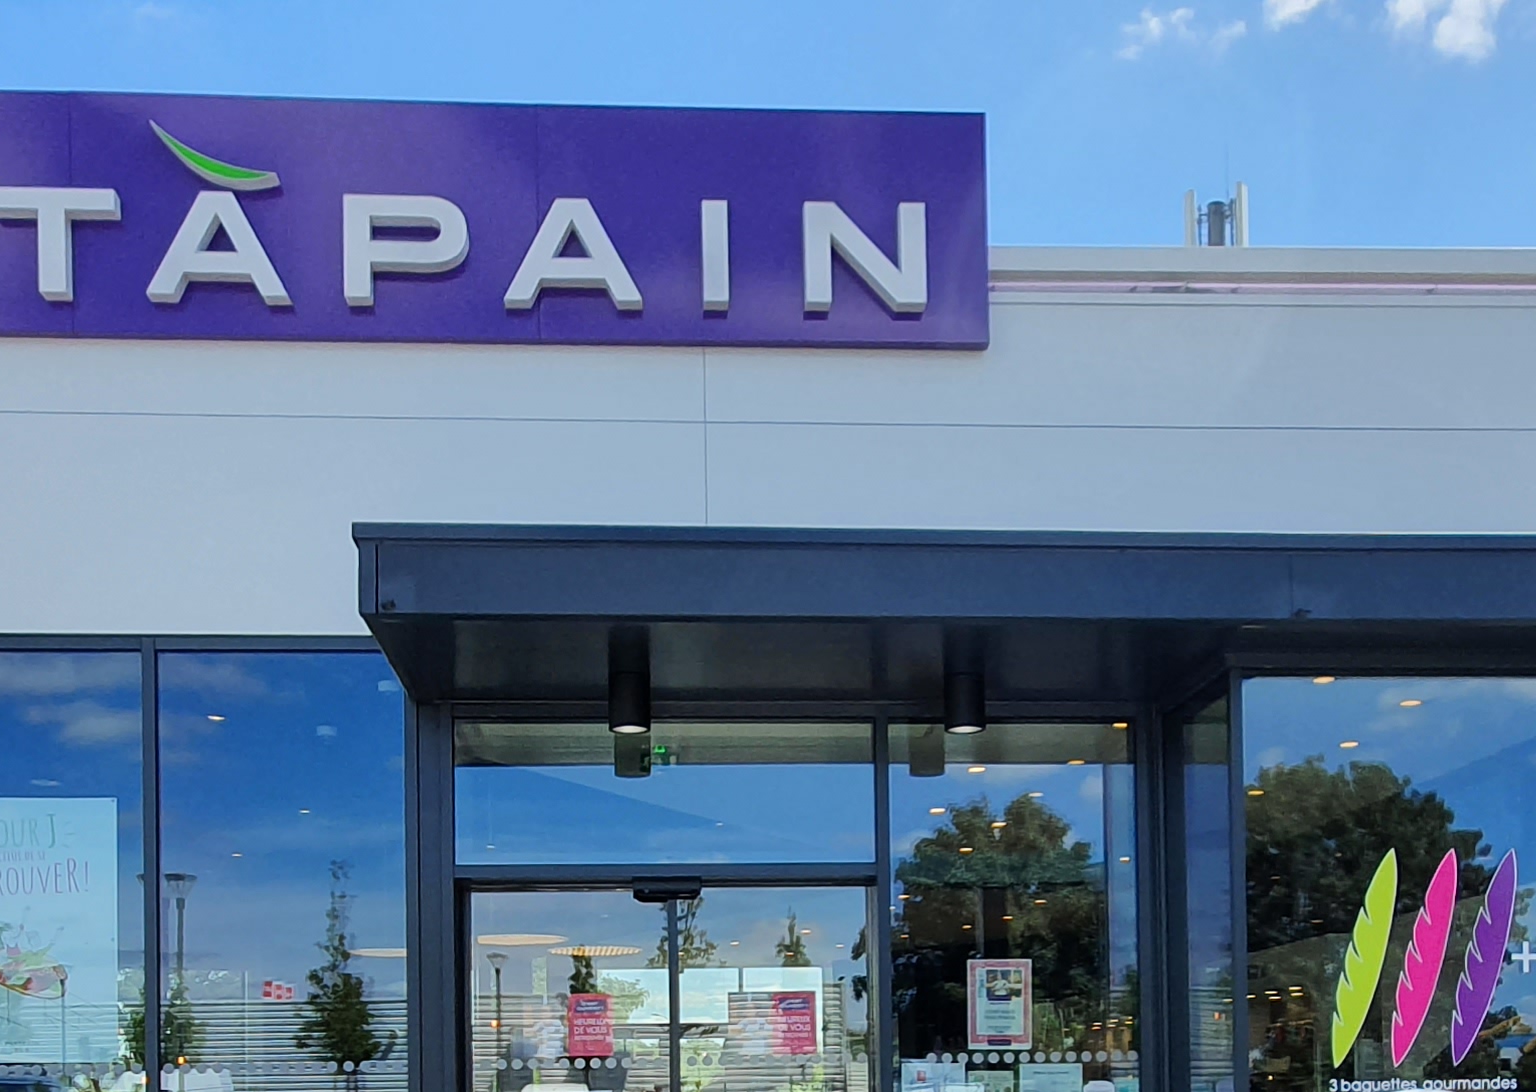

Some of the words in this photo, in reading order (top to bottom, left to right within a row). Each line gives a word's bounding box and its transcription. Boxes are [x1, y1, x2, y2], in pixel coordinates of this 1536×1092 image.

[46, 813, 57, 849] J
[1328, 1078, 1338, 1092] 3
[1422, 1076, 1518, 1092] gourmandes
